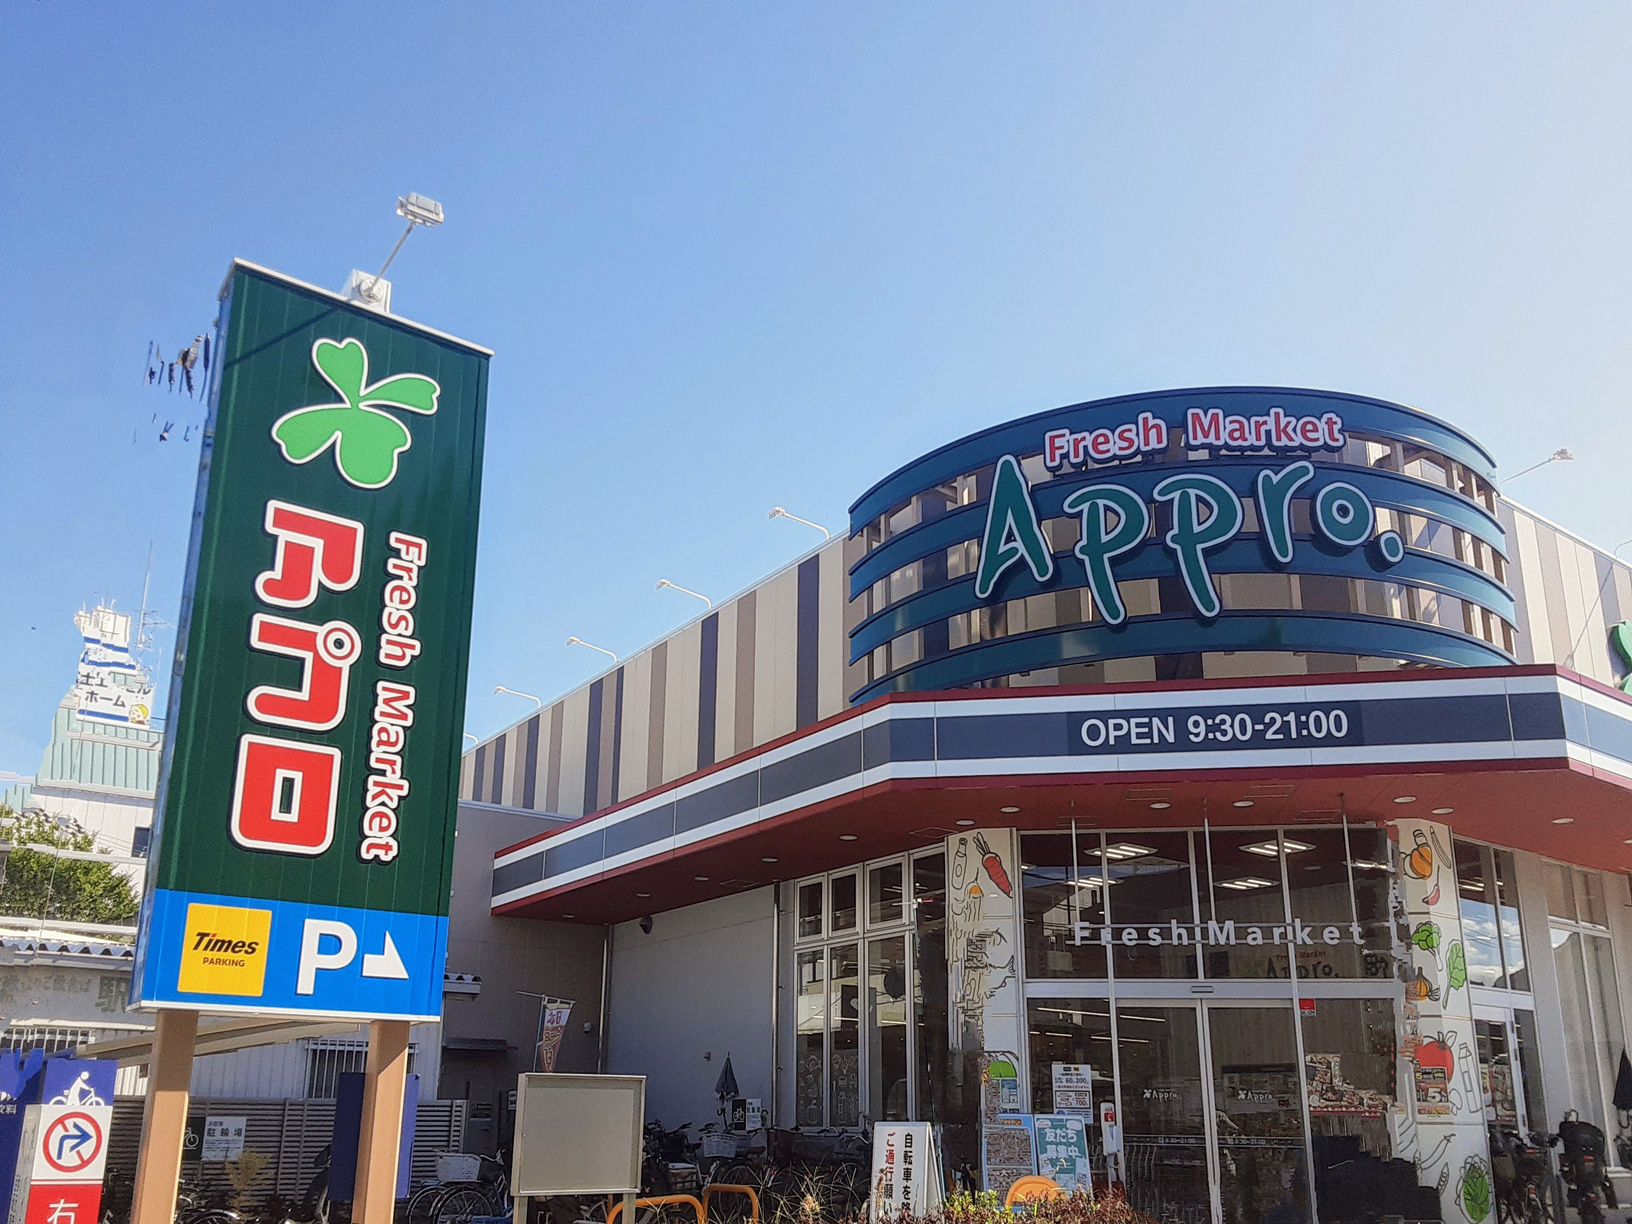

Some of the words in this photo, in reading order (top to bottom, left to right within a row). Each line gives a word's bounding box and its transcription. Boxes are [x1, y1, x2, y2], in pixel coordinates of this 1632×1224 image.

[1044, 411, 1167, 468] Fresh
[1185, 407, 1344, 449] Market
[974, 453, 1404, 626] Appro.
[380, 530, 428, 667] Fresh
[85, 690, 126, 708] ホーム
[232, 499, 365, 855] アプロ
[1080, 715, 1176, 749] OPEN
[1187, 709, 1349, 744] 9:30-21:00
[361, 680, 416, 862] Market
[192, 931, 260, 956] Times
[202, 956, 246, 968] PARKING
[296, 918, 358, 995] P
[1044, 1128, 1078, 1144] 友だち
[46, 1198, 79, 1224] 右
